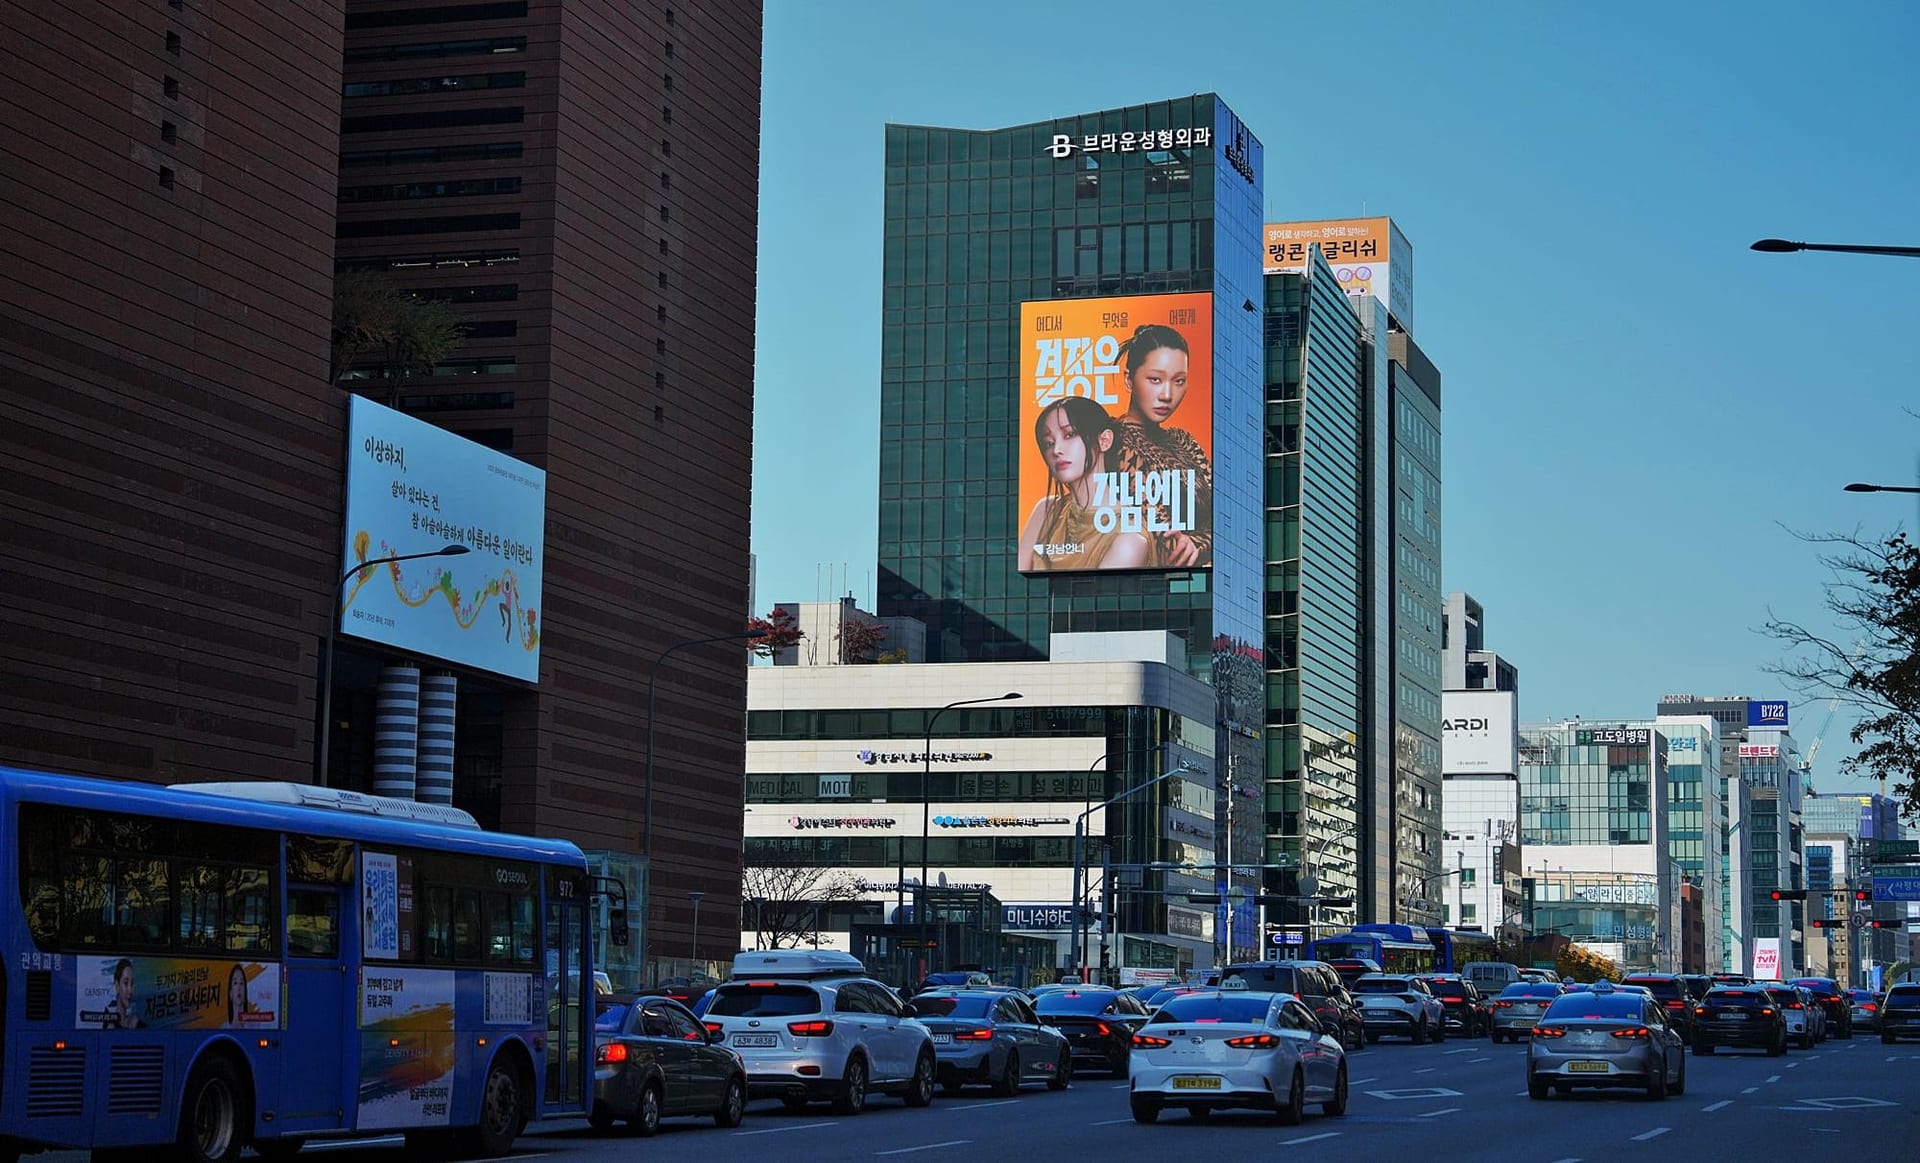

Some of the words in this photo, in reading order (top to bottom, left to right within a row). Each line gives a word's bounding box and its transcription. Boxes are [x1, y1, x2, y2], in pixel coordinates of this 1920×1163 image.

[1082, 126, 1212, 153] 브라운성형외과
[1268, 230, 1293, 241] 영어로
[1321, 226, 1347, 238] 영어로
[1268, 239, 1378, 263] 랭콘글리쉬
[1036, 315, 1063, 332] 어디서
[1102, 312, 1129, 328] 무엇을
[1169, 309, 1196, 325] 어떻게
[364, 435, 407, 474] 이상하지,
[391, 480, 407, 499] 살아
[408, 485, 430, 508] 있다는
[411, 512, 419, 531] 참
[421, 516, 465, 543] 아슬아슬하게
[466, 525, 501, 555] 아름다운
[503, 541, 534, 567] 일이란다
[1045, 542, 1085, 556] 강남언니
[1761, 704, 1784, 718] B722
[1442, 718, 1489, 731] ARDI
[1592, 730, 1648, 744] 고도일병원
[749, 780, 804, 795] MEDICAL
[820, 780, 869, 795] MOTIVE
[508, 871, 528, 885] SEOUL
[1757, 955, 1776, 963] tvN
[144, 992, 178, 1021] 지금은
